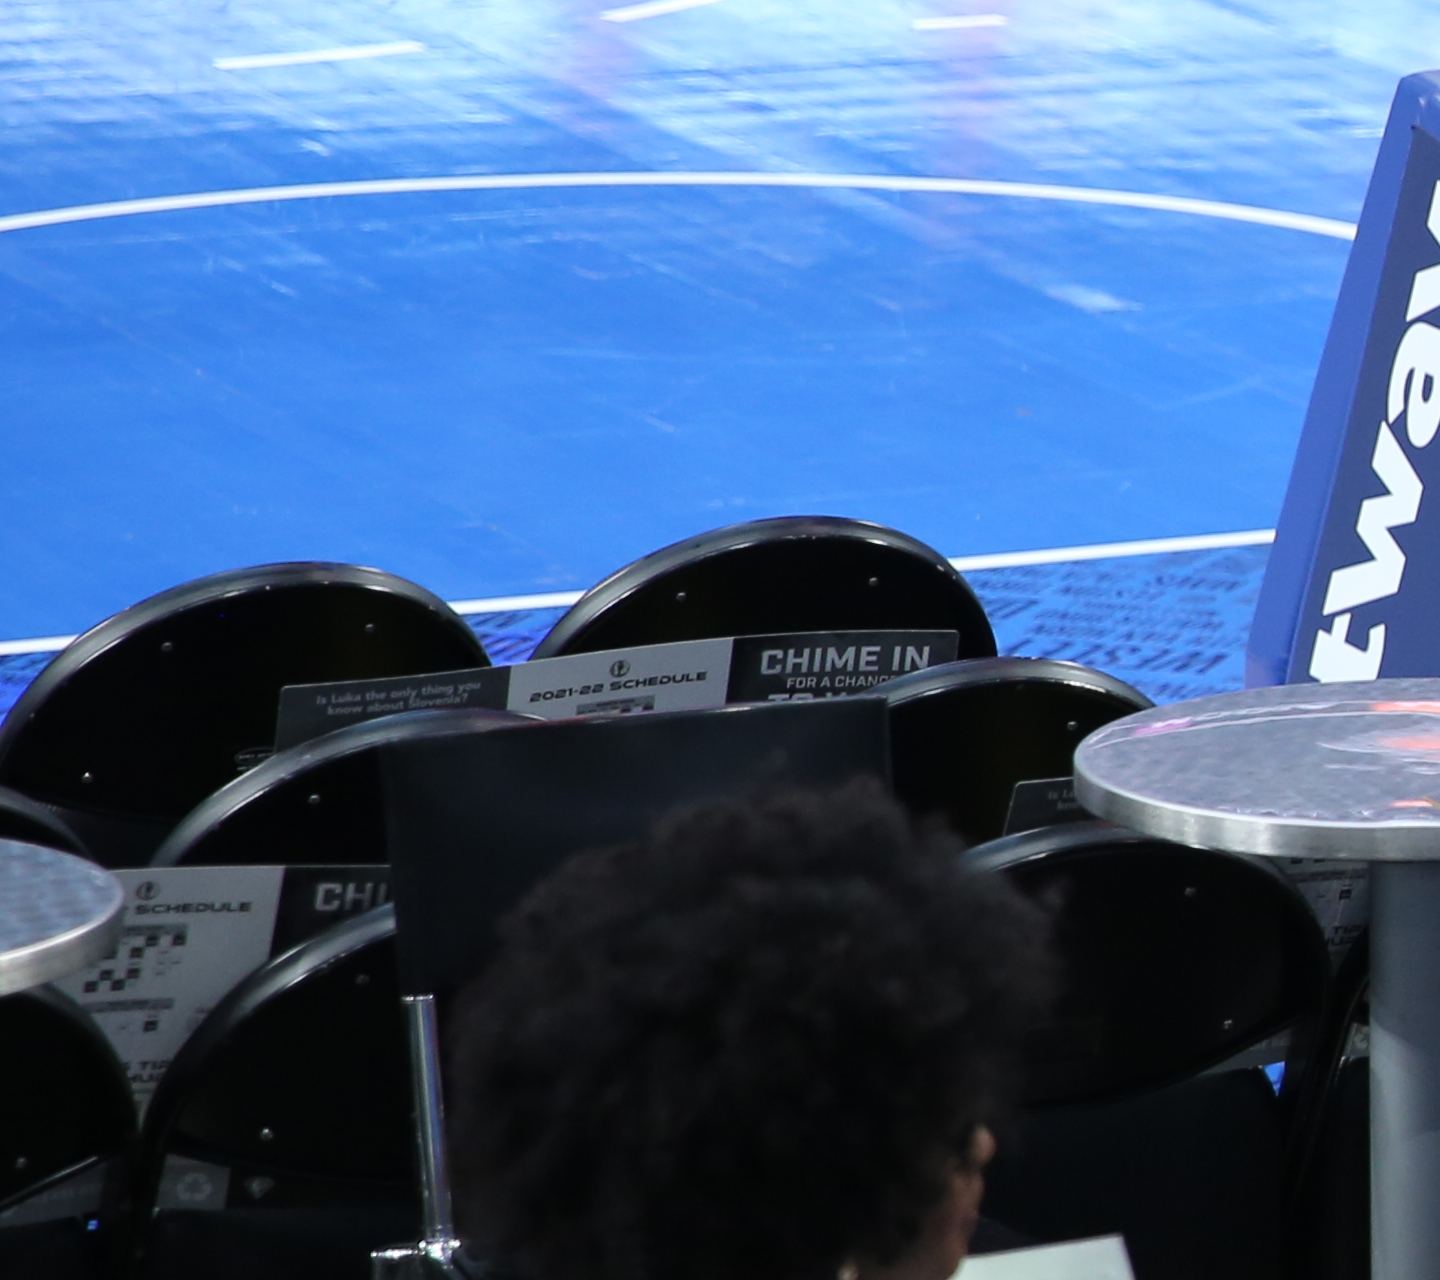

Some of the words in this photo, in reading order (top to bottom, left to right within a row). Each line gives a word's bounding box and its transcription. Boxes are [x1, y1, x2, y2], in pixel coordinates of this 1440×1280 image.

[759, 645, 887, 675] CHIME
[892, 645, 931, 671] IN
[316, 695, 326, 705] Is
[331, 692, 361, 704] Luka
[365, 690, 387, 701] the
[390, 686, 417, 700] only
[421, 684, 454, 697] thing
[458, 681, 482, 694] you
[529, 683, 605, 703] 2021-22
[609, 671, 708, 692] SCHEDULE
[786, 676, 816, 689] FOR
[820, 676, 831, 688] A
[834, 674, 897, 688] CHANC
[326, 705, 363, 716] know
[366, 701, 404, 713] about
[408, 693, 469, 709] Slovenia?
[134, 901, 253, 915] SCHEDULE
[314, 882, 388, 912] CHI
